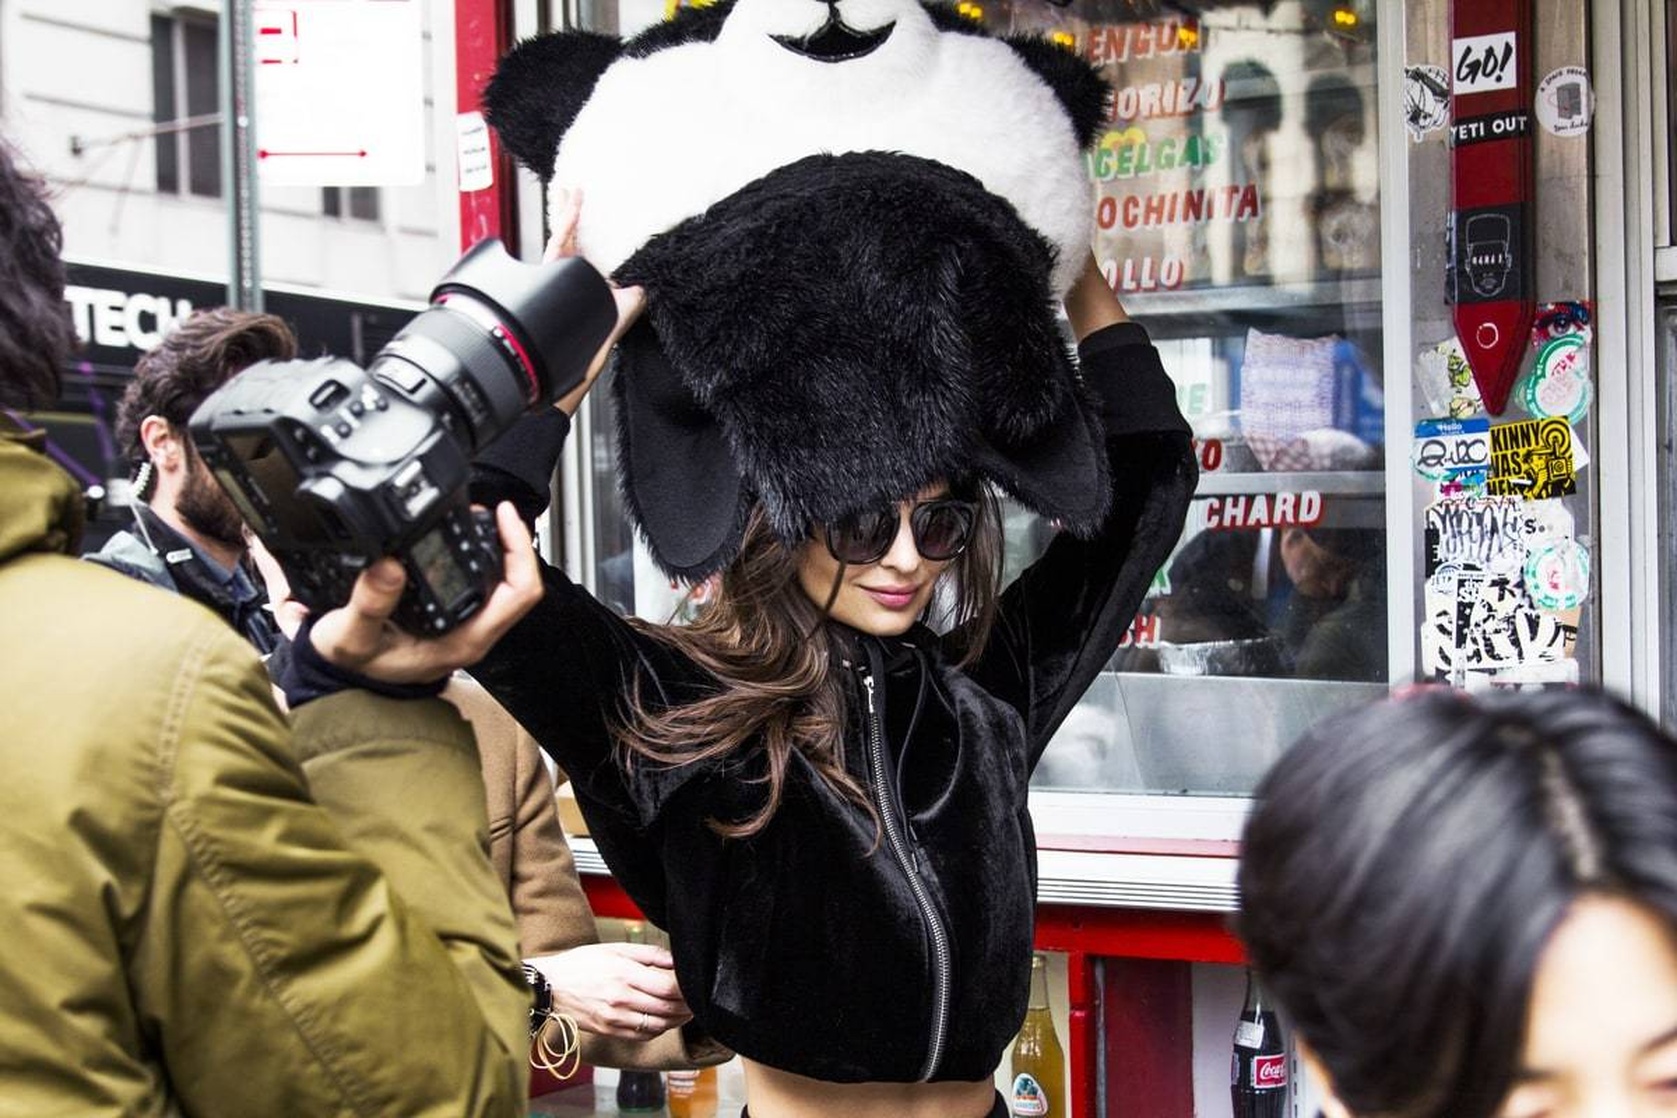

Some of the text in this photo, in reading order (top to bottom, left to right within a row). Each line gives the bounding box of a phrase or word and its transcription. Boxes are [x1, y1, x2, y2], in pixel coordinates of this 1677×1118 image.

[1455, 41, 1513, 85] GO!
[1451, 115, 1528, 141] YETI OUT
[1083, 134, 1224, 181] CELGAS
[1491, 421, 1540, 452] KINNY
[1204, 490, 1324, 531] CHARD
